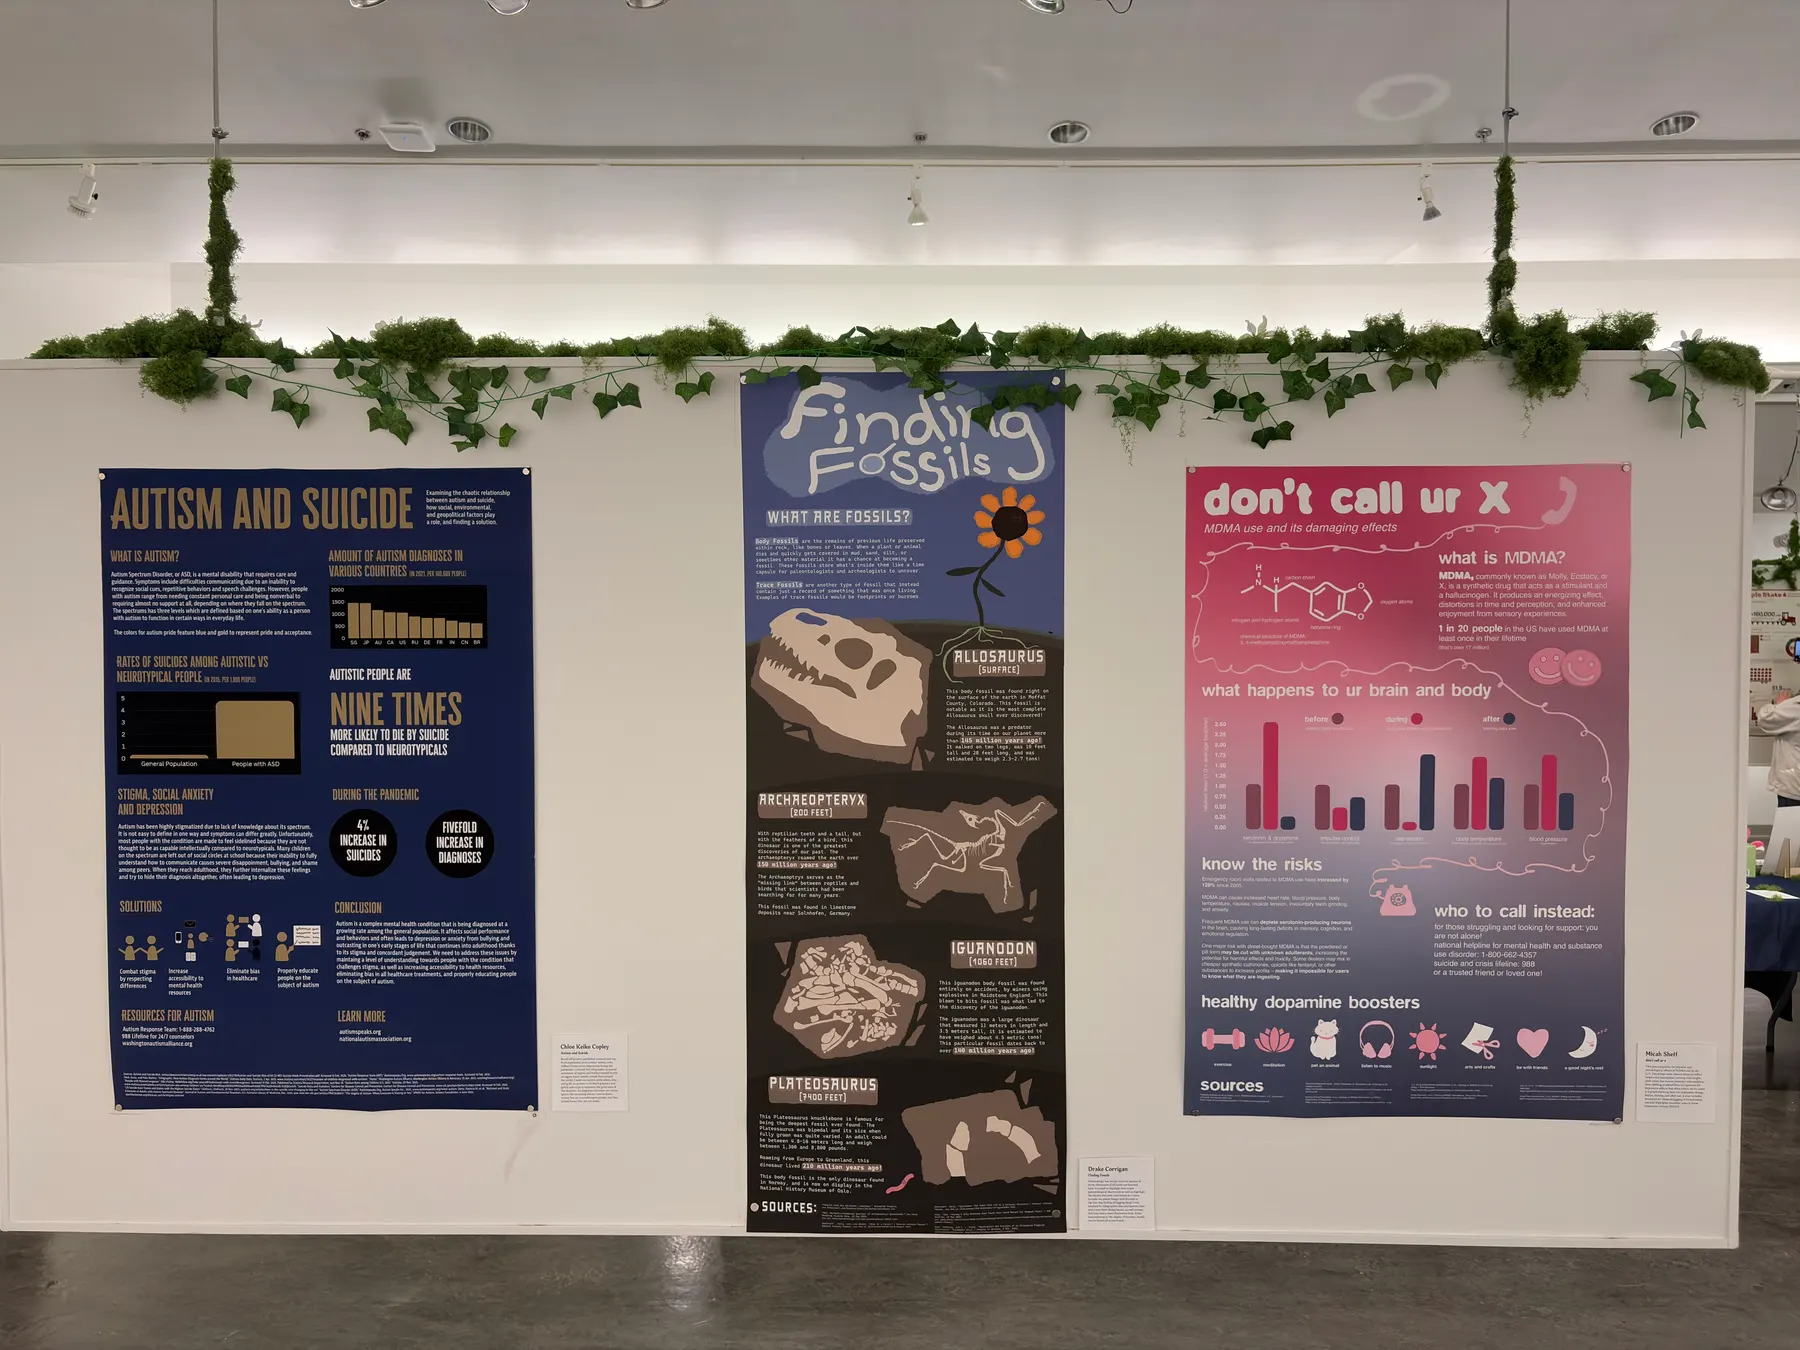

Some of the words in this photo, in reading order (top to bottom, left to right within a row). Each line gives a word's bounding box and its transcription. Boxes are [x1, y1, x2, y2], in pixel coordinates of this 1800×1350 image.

[808, 442, 991, 494] Fossils
[1204, 477, 1313, 516] don't
[1330, 481, 1403, 514] call
[1420, 488, 1461, 514] ur
[1478, 481, 1511, 514] X
[110, 487, 222, 530] AUTISM
[233, 487, 291, 529] AND
[302, 487, 413, 530] SUICIDE
[768, 510, 808, 524] WHAT
[813, 510, 840, 523] ARE
[846, 510, 910, 523] FOSSILS?
[1204, 523, 1241, 533] MDMA
[1243, 525, 1263, 533] use
[1266, 523, 1288, 533] and
[1290, 523, 1303, 532] its
[1305, 523, 1359, 535] damaging
[1362, 522, 1397, 532] effects
[110, 550, 132, 562] WHAT
[134, 550, 142, 562] IS
[144, 550, 180, 562] AUTISM?
[328, 550, 362, 562] AMOUNT
[364, 549, 374, 562] OF
[376, 549, 407, 562] AUTISM
[409, 549, 452, 562] DIAGNOSES
[454, 549, 463, 562] IN
[1439, 551, 1477, 564] what
[1484, 550, 1498, 564] is
[1505, 550, 1566, 564] MDMA?
[328, 565, 362, 577] VARIOUS
[364, 565, 407, 577] COUNTRIES
[1438, 625, 1443, 633] 1
[1446, 624, 1455, 633] in
[1457, 625, 1469, 633] 20
[1472, 624, 1503, 634] people
[116, 655, 140, 668] RATES
[142, 655, 151, 668] OF
[153, 655, 188, 668] SUICIDES
[190, 656, 218, 668] AMONG
[220, 655, 256, 668] AUTISTIC
[257, 655, 268, 668] VS
[954, 650, 1043, 663] ALLOSAURUS
[117, 670, 173, 683] NEUROTYPICAL
[175, 670, 202, 683] PEOPLE
[329, 668, 365, 680] AUTISTIC
[367, 668, 394, 680] PEOPLE
[396, 668, 411, 680] ARE
[1202, 683, 1240, 697] what
[1248, 683, 1315, 700] happens
[1322, 683, 1339, 697] to
[1346, 686, 1362, 697] ur
[1369, 683, 1408, 697] brain
[1416, 683, 1444, 697] and
[1452, 683, 1491, 699] body
[331, 692, 384, 726] NINE
[392, 692, 462, 726] TIMES
[1482, 715, 1500, 723] after
[330, 729, 353, 741] MORE
[354, 729, 378, 741] LIKELY
[380, 728, 390, 741] TO
[392, 729, 405, 741] DIE
[407, 729, 417, 741] BY
[419, 728, 449, 741] SUICIDE
[330, 744, 372, 756] COMPARED
[374, 743, 384, 756] TO
[386, 743, 448, 756] NEUROTYPICALS
[118, 788, 150, 801] STIGMA,
[152, 788, 180, 800] SOCIAL
[182, 788, 214, 800] ANXIETY
[332, 788, 362, 800] DURING
[363, 788, 378, 800] THE
[380, 788, 419, 800] PANDEMIC
[759, 794, 865, 806] ARCHAEOPTERYX
[118, 803, 134, 815] AND
[136, 803, 183, 815] DEPRESSION
[357, 819, 369, 831] 4%
[443, 821, 477, 833] FIVEFOLD
[340, 834, 377, 846] INCREASE
[379, 834, 387, 846] IN
[436, 836, 473, 848] INCREASE
[475, 836, 484, 848] IN
[346, 849, 381, 861] SUICIDES
[439, 851, 482, 863] DIAGNOSES
[1202, 857, 1245, 870] know
[1252, 857, 1277, 871] the
[1284, 857, 1322, 871] risks
[119, 900, 162, 912] SOLUTIONS
[335, 901, 382, 914] CONCLUSION
[1434, 904, 1468, 917] who
[1475, 904, 1492, 918] to
[1499, 904, 1526, 918] call
[1534, 904, 1595, 918] instead:
[952, 942, 1034, 955] IGUANODON
[1481, 951, 1538, 959] 1-800-662-4357
[1202, 994, 1258, 1011] healthy
[1265, 995, 1342, 1011] dopamine
[1349, 996, 1420, 1009] boosters
[121, 1009, 165, 1021] RESOURCES
[167, 1009, 182, 1021] FOR
[184, 1009, 214, 1021] AUTISM
[338, 1010, 361, 1022] LEARN
[364, 1010, 386, 1022] MORE
[770, 1077, 876, 1091] PLATEOSAURUS
[1200, 1081, 1264, 1092] sources
[762, 1201, 817, 1213] SOURCES:
